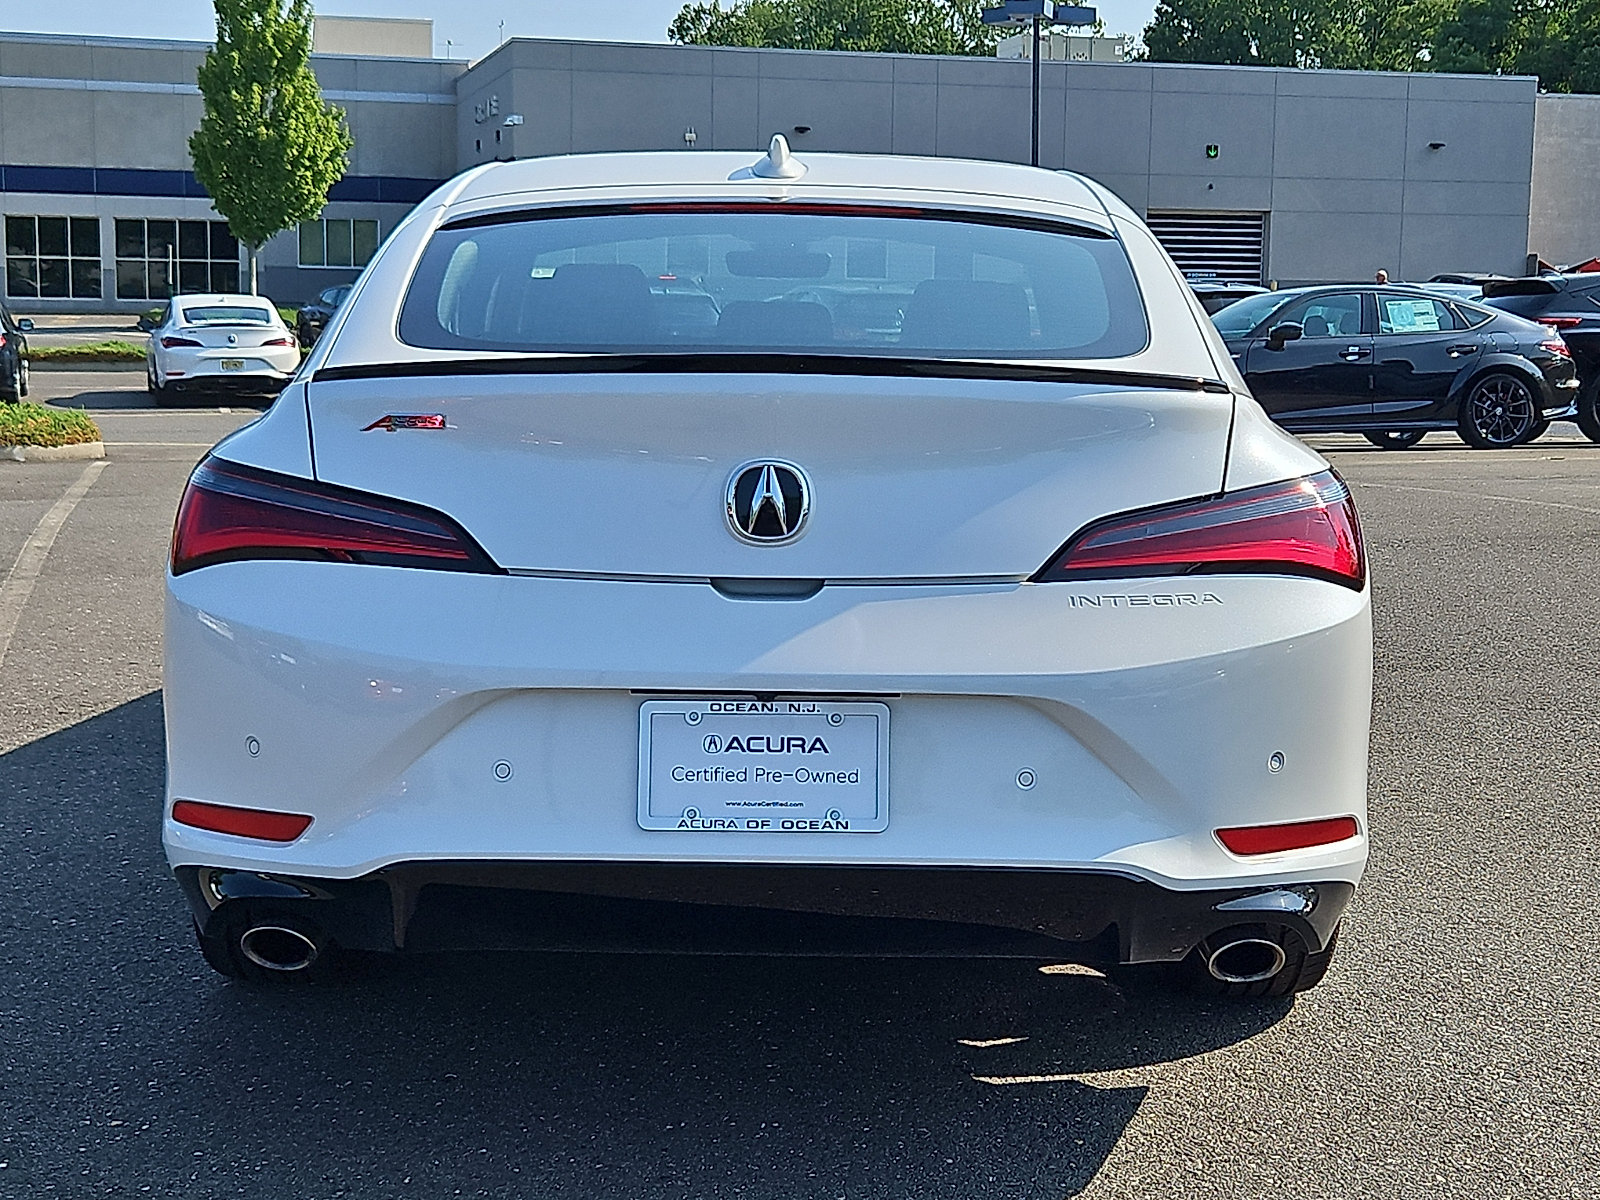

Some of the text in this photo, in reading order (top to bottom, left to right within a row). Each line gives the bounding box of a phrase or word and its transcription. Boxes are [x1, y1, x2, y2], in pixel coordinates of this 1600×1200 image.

[1068, 593, 1224, 608] INTEGRA
[709, 702, 821, 713] OCEAN, N.J.
[723, 736, 830, 754] ACURA
[671, 766, 859, 784] Certified Pre-Owned
[676, 819, 850, 830] ACURA OF OCEAN
